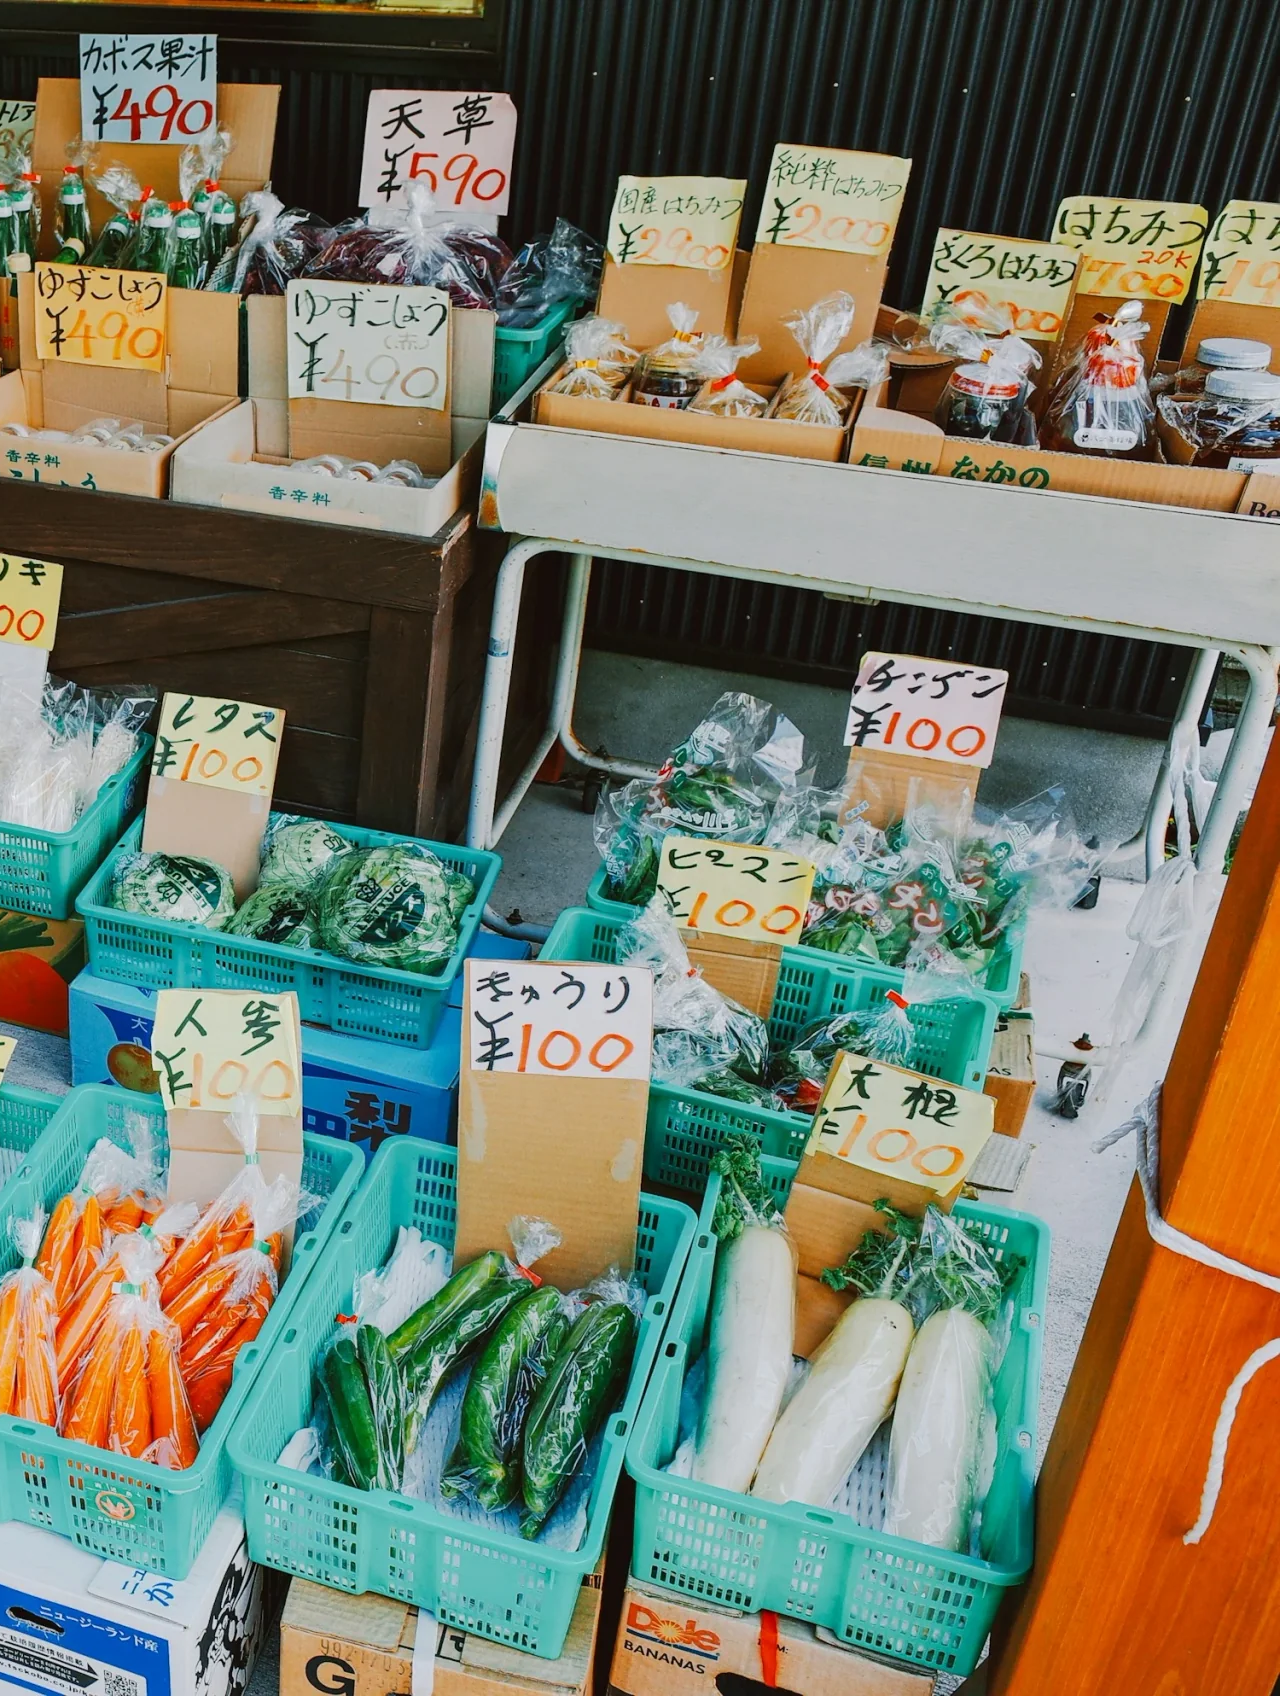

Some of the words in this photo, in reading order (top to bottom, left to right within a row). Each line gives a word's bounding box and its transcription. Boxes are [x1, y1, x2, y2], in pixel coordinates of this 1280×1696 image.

[82, 37, 213, 81] カボス果汁
[92, 83, 213, 141] ¥490
[381, 95, 495, 146] 天草
[376, 143, 506, 206] ¥590
[618, 185, 744, 221] 国産はちみつ
[765, 196, 891, 248] ¥2000
[1059, 203, 1206, 249] はちみつ
[45, 305, 165, 361] ¥490
[293, 287, 449, 337] ゆずこしょう
[293, 330, 441, 402] ¥490
[5, 448, 61, 469] 香辛料
[268, 486, 332, 508] 香辛料
[172, 696, 278, 743] レタス
[851, 702, 987, 757] ¥100
[667, 847, 810, 884] ピーマン
[656, 882, 803, 936] ¥100
[475, 969, 632, 1014] きゅうり
[174, 998, 281, 1057] 人参
[475, 1010, 634, 1073] ¥100
[154, 1047, 293, 1107] ¥100
[840, 1063, 962, 1128] 大根
[38, 1605, 160, 1654] ニュージーランド産
[627, 1602, 721, 1652] Dole
[624, 1639, 706, 1675] BANANAS
